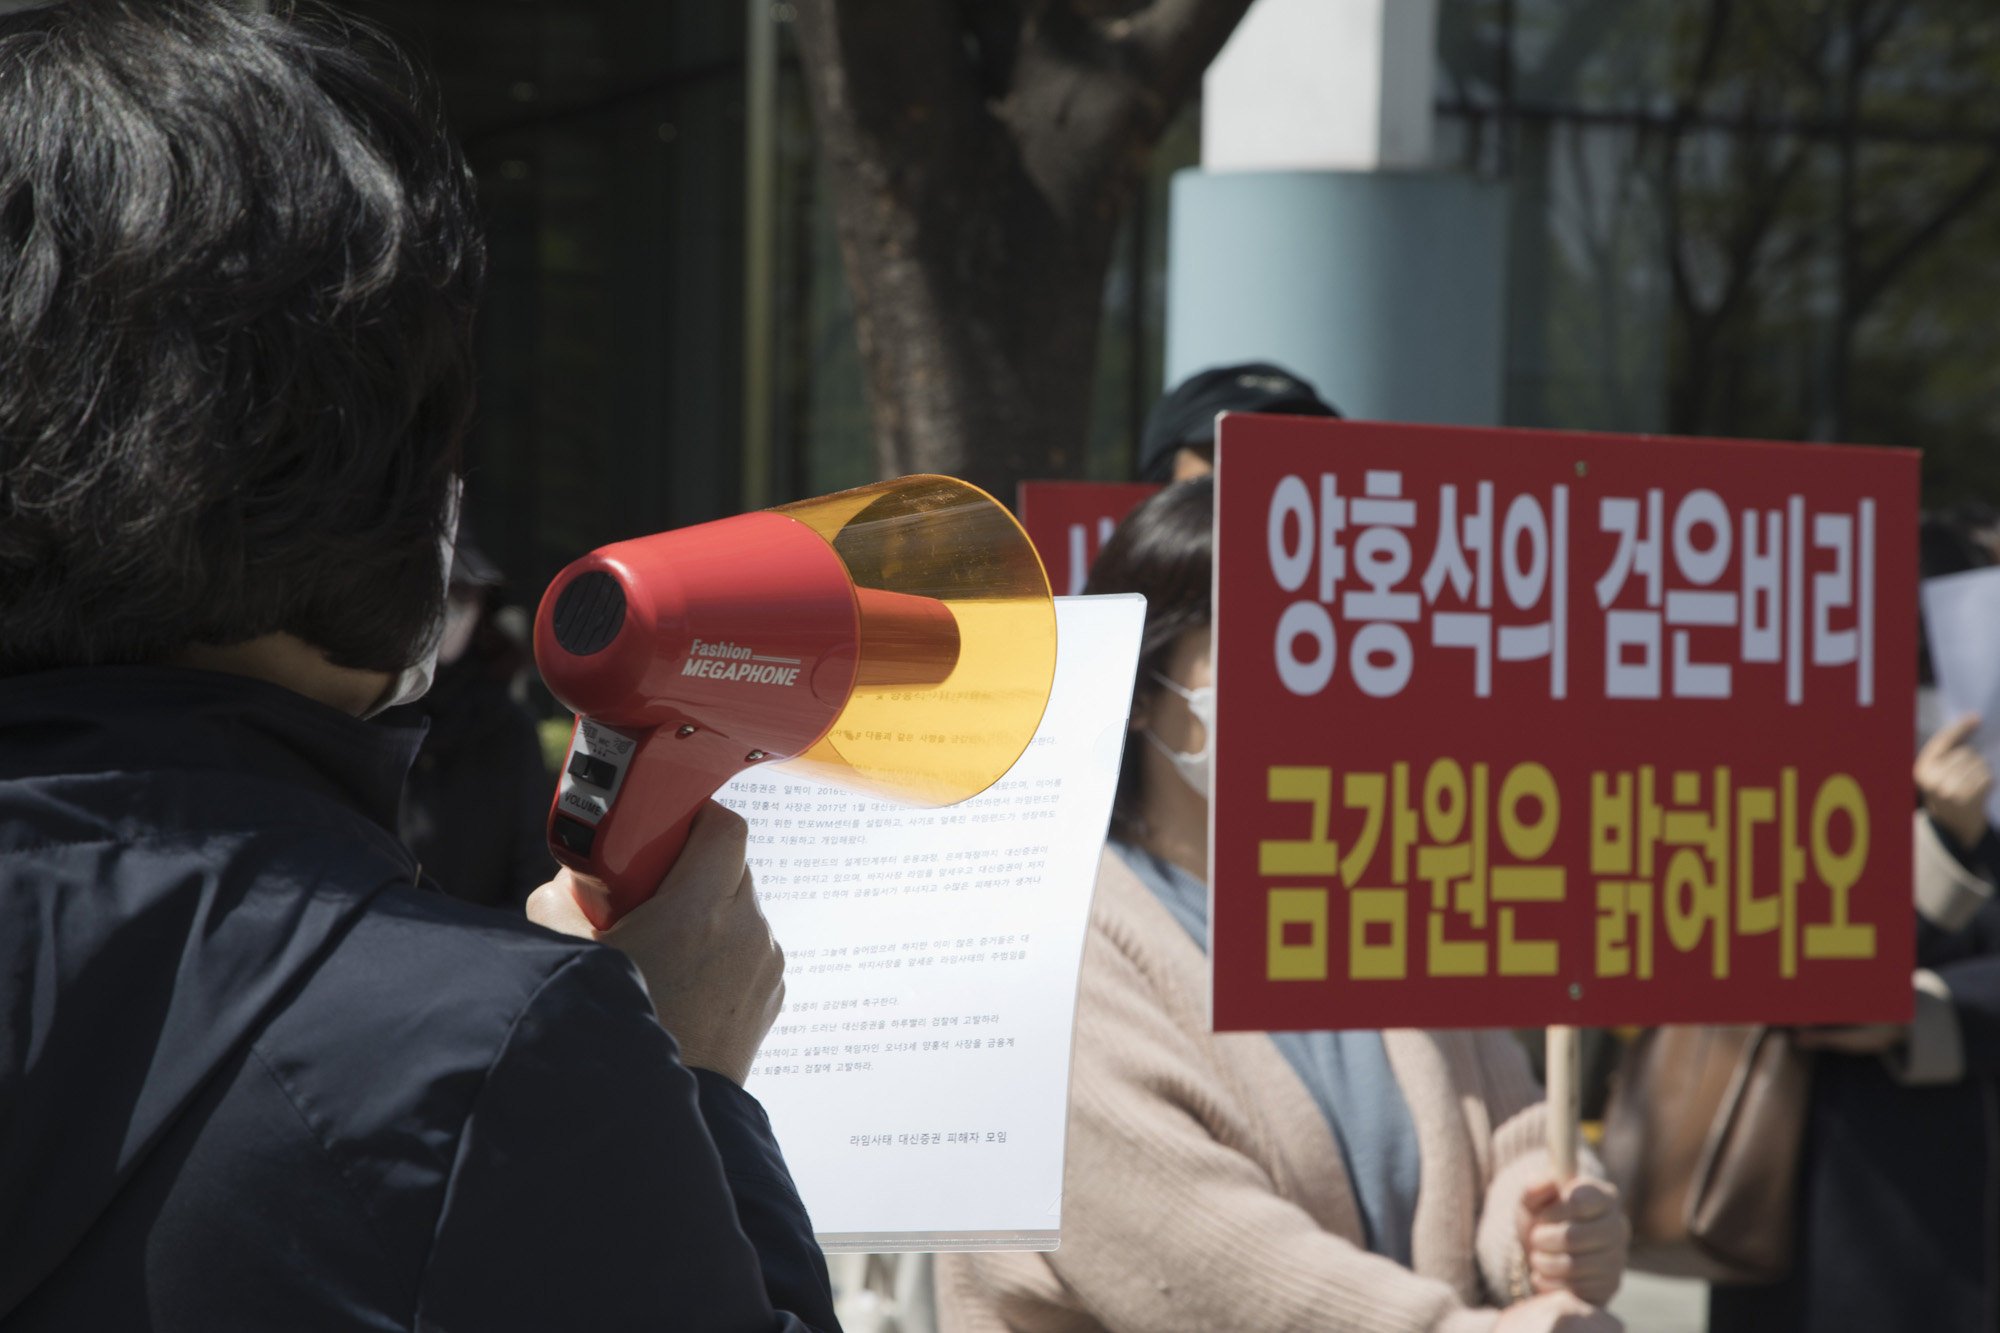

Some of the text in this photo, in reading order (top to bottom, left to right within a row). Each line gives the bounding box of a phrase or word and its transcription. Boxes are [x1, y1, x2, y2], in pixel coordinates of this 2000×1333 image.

[1267, 470, 1876, 706] 양홍석의 검은비리
[690, 638, 752, 660] Fashion
[681, 658, 800, 686] MEGAPHONE
[730, 782, 777, 794] 대신증권은
[784, 785, 811, 795] 일찍이
[564, 791, 602, 817] VOLUME
[752, 800, 780, 811] 양홍석
[785, 802, 812, 812] 사장은
[817, 803, 847, 812] 2017년
[853, 803, 866, 812] 1월
[774, 819, 792, 828] 위한
[780, 836, 816, 846] 지원하고
[821, 836, 868, 845] 개입해왔다.
[779, 858, 788, 868] 된
[794, 858, 838, 867] 라임펀드의
[1259, 758, 1876, 980] 금감원은 밝혀다오
[761, 874, 787, 885] 증거는
[769, 1025, 807, 1035] 기행태가
[850, 1131, 1007, 1147] 라임사태 대신증권 피해자 모임
